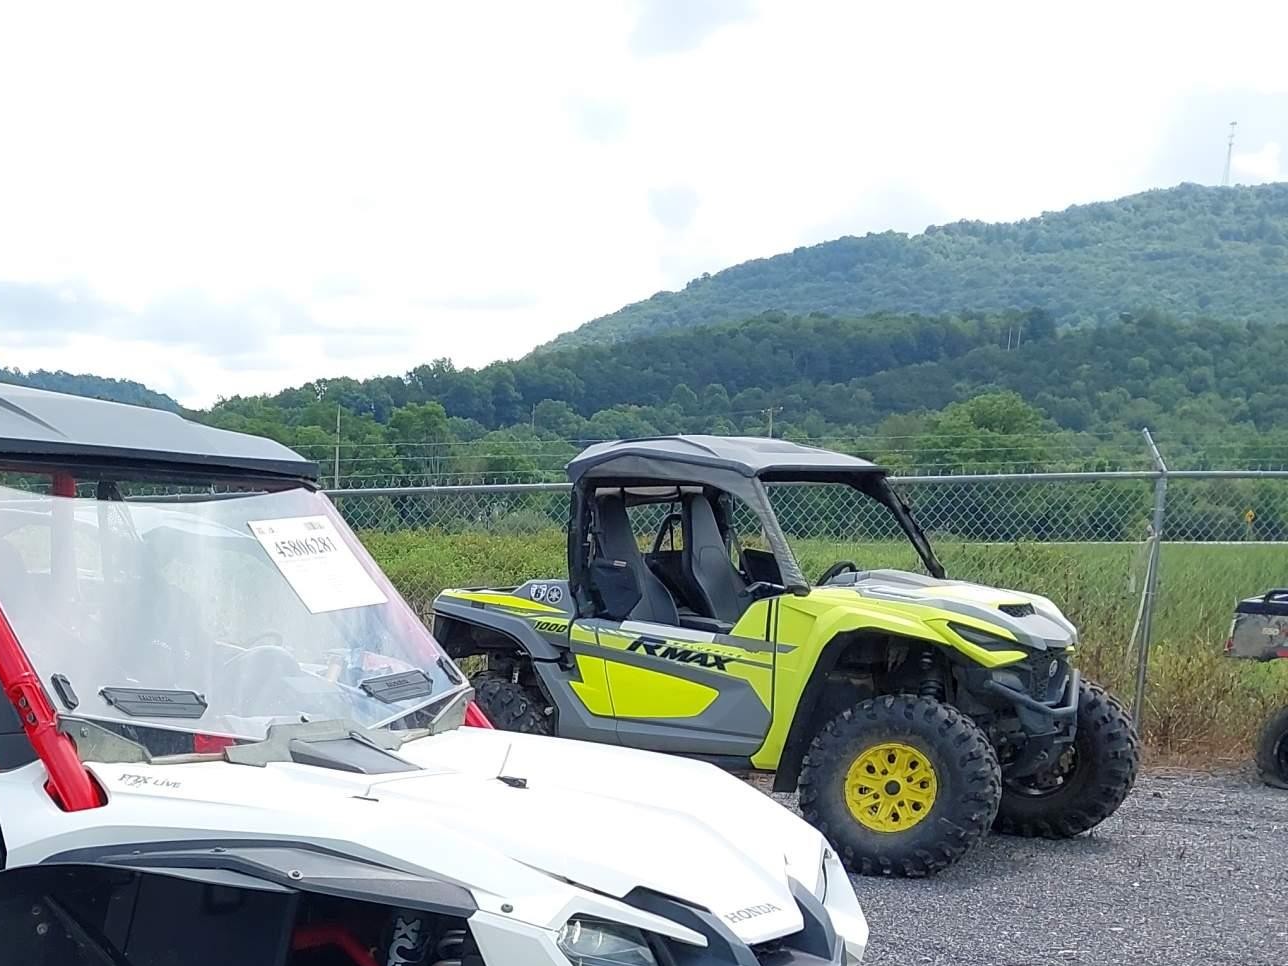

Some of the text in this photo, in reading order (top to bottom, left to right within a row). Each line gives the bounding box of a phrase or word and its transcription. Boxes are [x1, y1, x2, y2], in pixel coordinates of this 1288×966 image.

[275, 536, 338, 558] 45806281
[534, 620, 568, 633] 1000
[626, 635, 736, 672] RMAX
[723, 902, 783, 924] HONDA
